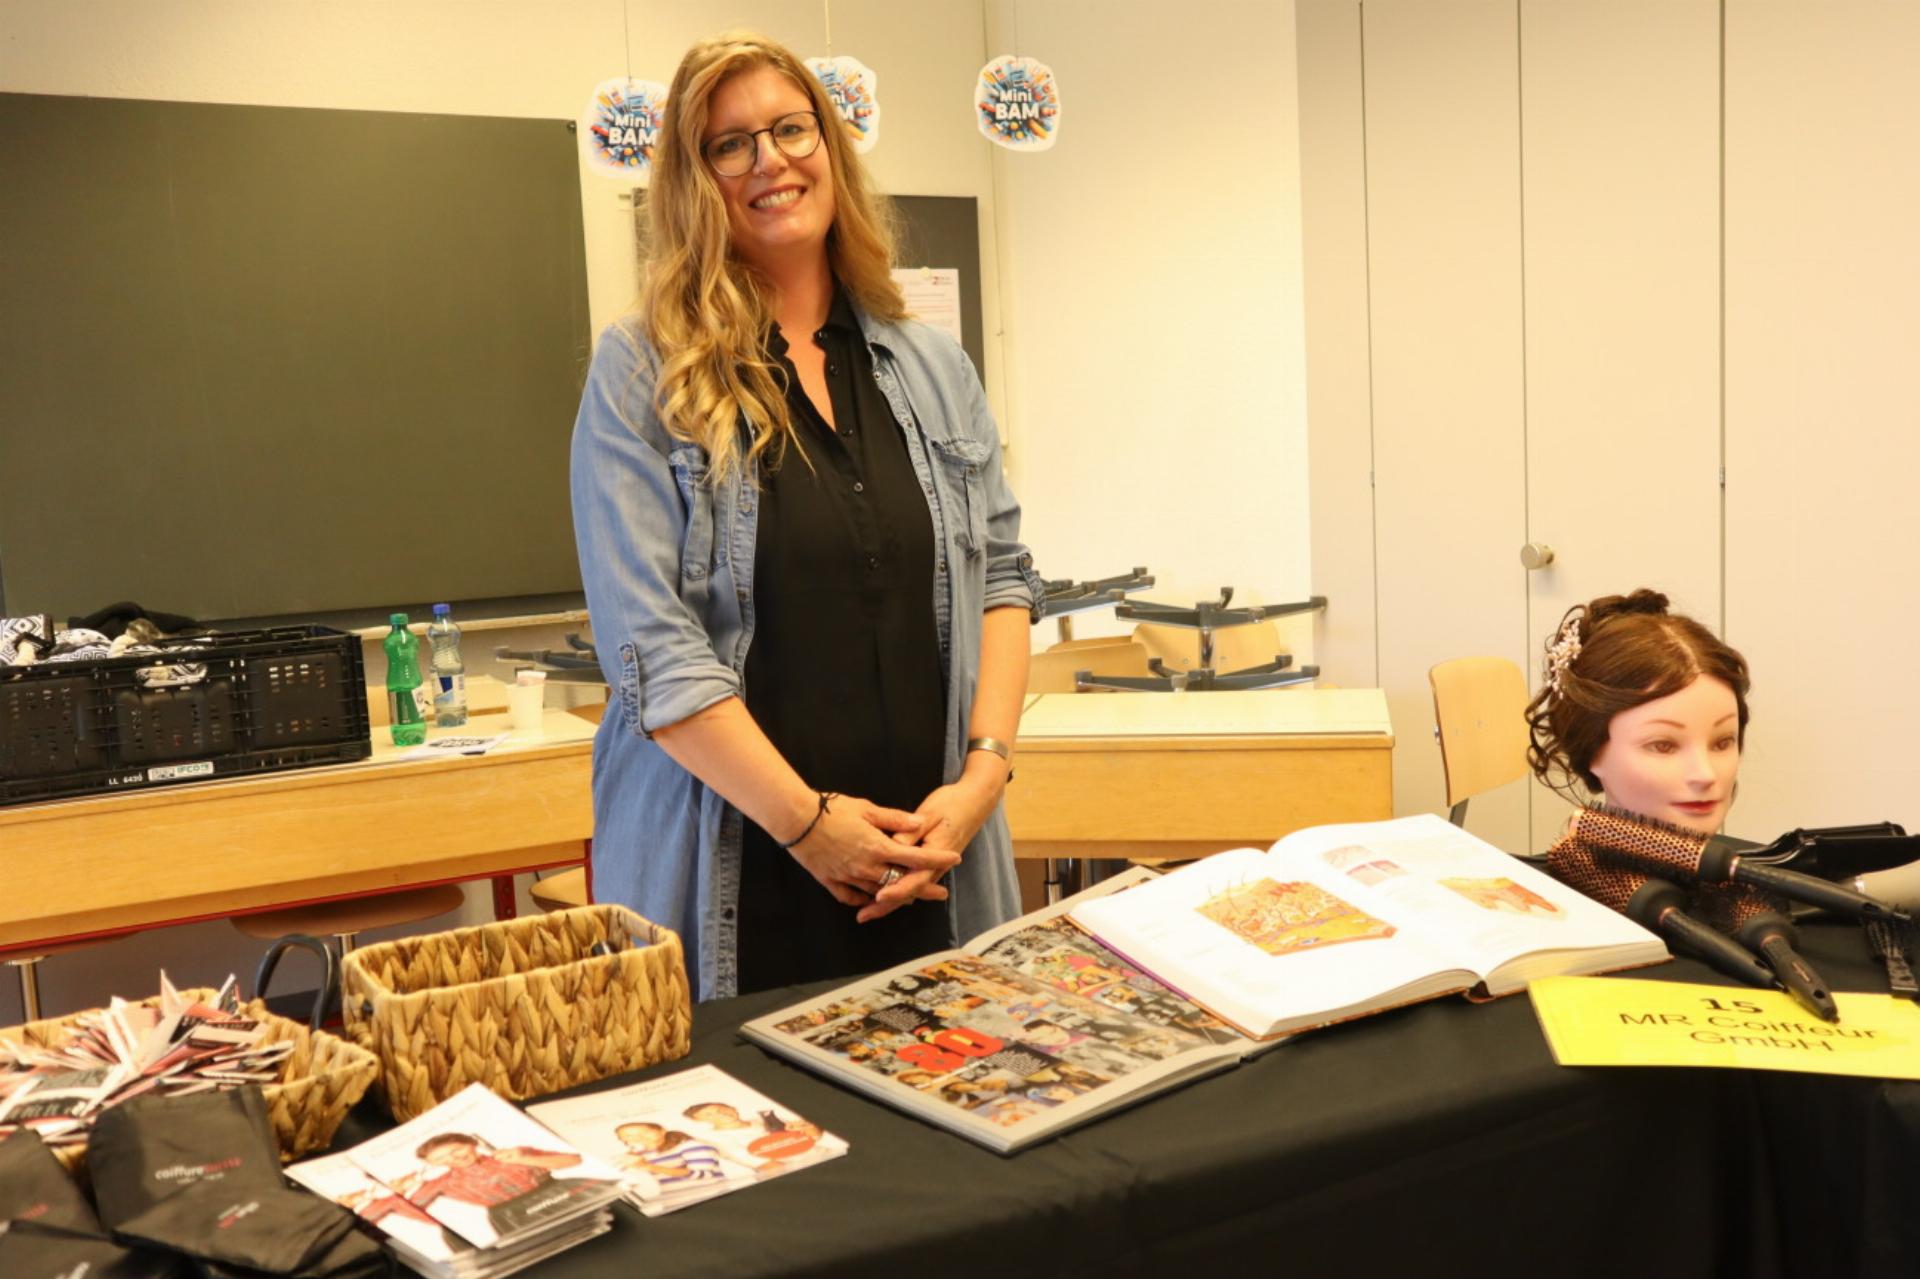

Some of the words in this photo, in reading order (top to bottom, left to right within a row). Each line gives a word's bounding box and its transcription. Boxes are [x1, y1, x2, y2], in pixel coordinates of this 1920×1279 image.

[999, 88, 1033, 102] Mini
[995, 102, 1040, 119] BAM
[614, 112, 651, 128] Mini
[608, 127, 659, 146] BAM
[1701, 998, 1764, 1014] 15
[1619, 1013, 1694, 1026] MR
[1708, 1016, 1877, 1039] Coiffeur
[1690, 1030, 1835, 1052] GmbH
